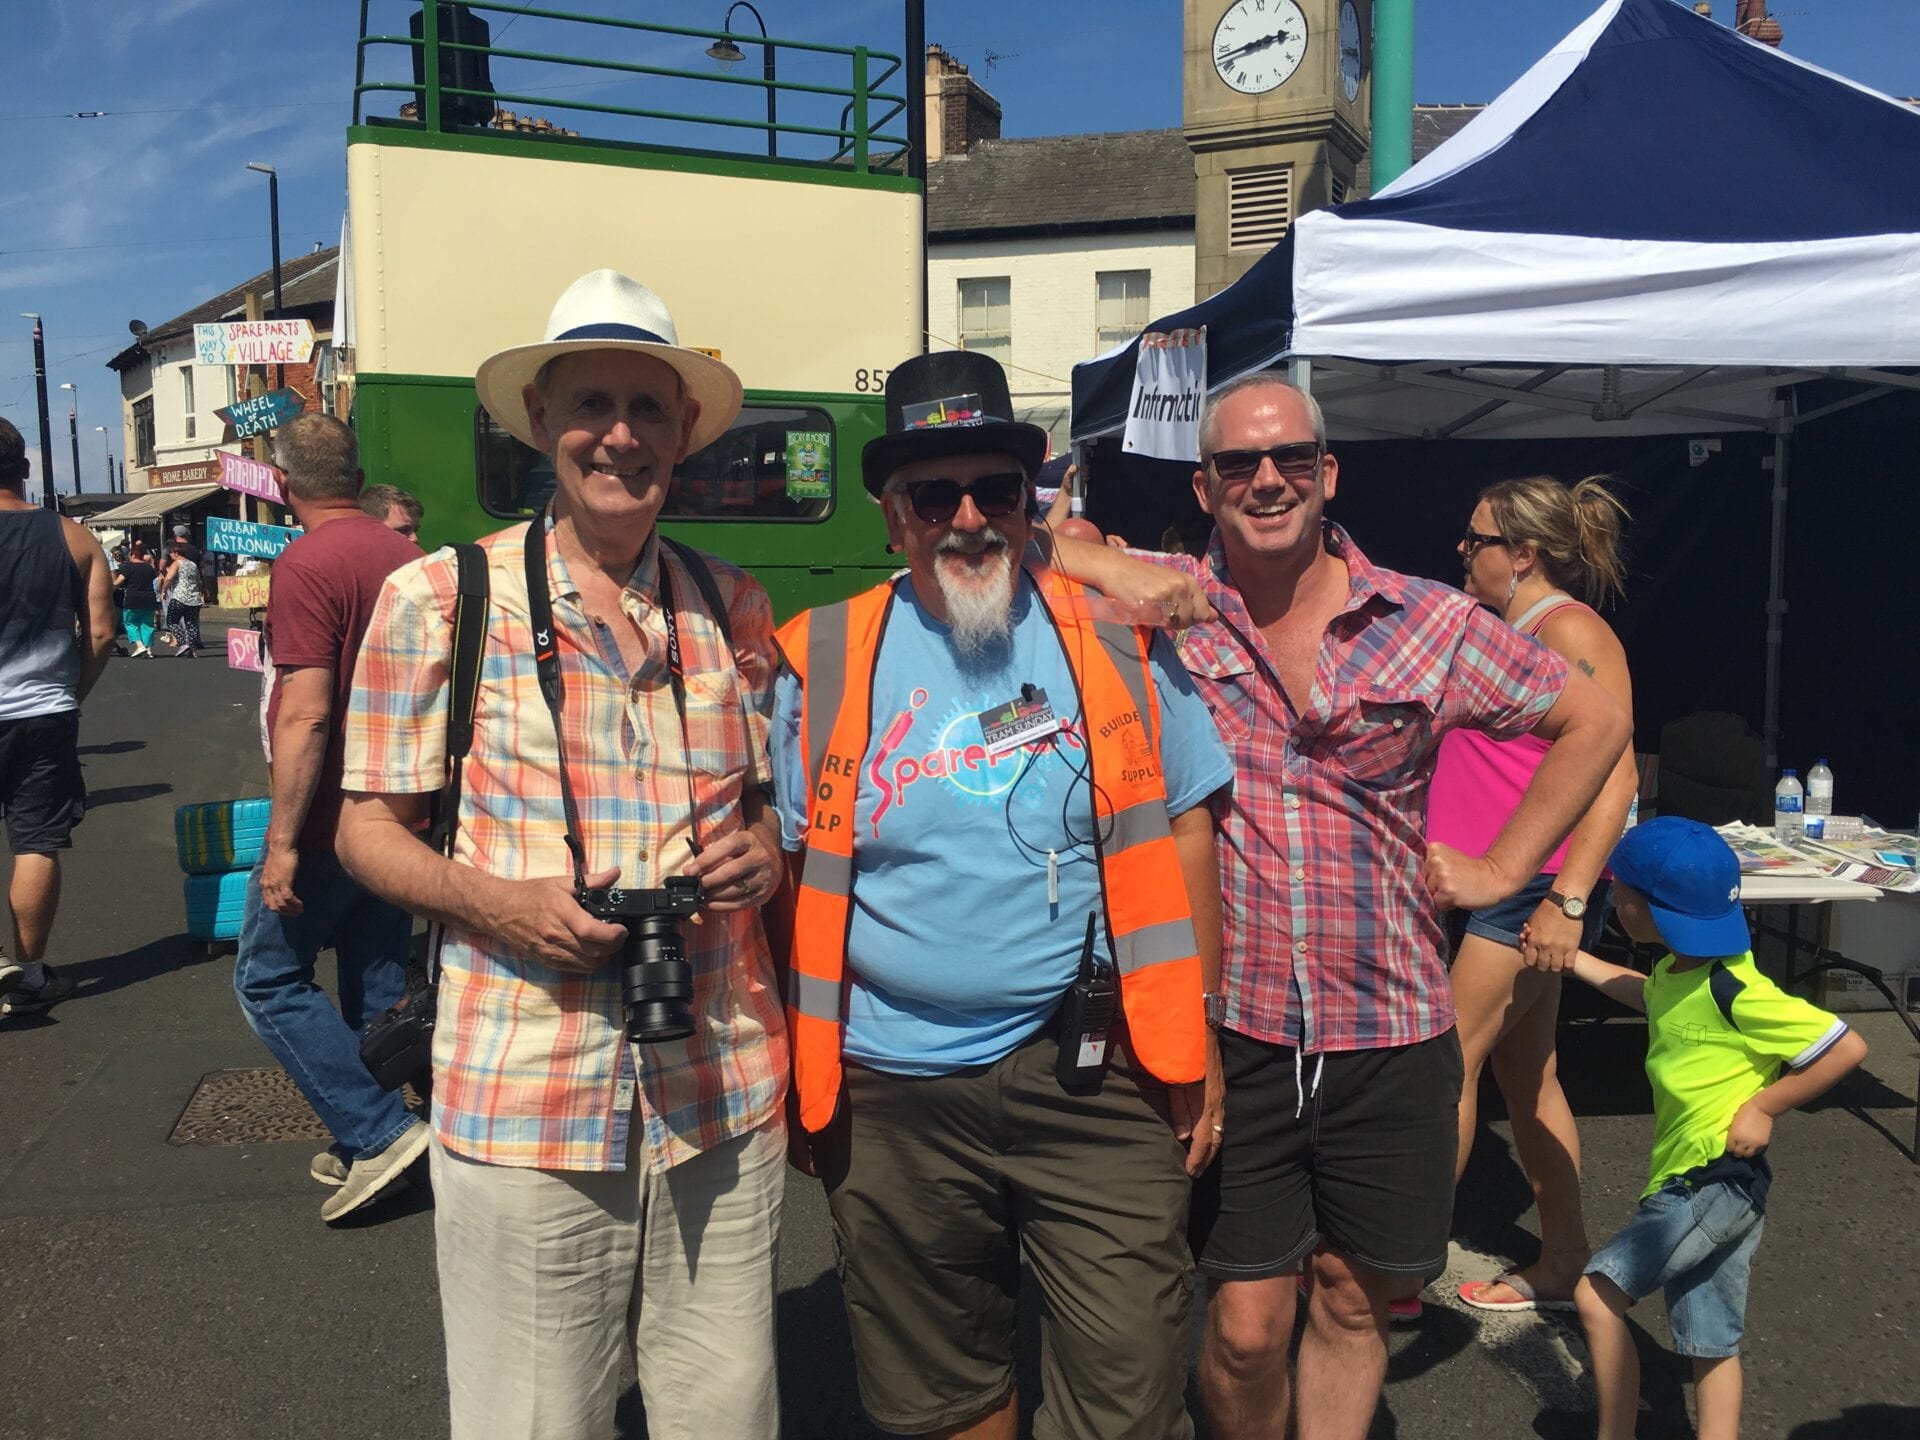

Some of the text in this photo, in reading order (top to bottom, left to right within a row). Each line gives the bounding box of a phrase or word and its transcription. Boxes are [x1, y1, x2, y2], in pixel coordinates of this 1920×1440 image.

[197, 325, 215, 336] THIS
[200, 339, 217, 352] WAY
[238, 341, 294, 363] VILLAGE
[201, 353, 214, 363] TO
[855, 368, 892, 392] 85
[231, 395, 275, 417] WHEEL
[235, 412, 278, 438] DEATH
[248, 413, 257, 423] OF
[162, 467, 208, 483] HOME BAKERY
[220, 521, 257, 535] URBAN
[213, 532, 286, 555] ASTRONAUT
[666, 608, 679, 663] SONY
[986, 711, 1054, 744] TRAM SUNDAY
[1099, 710, 1141, 738] BUILDE
